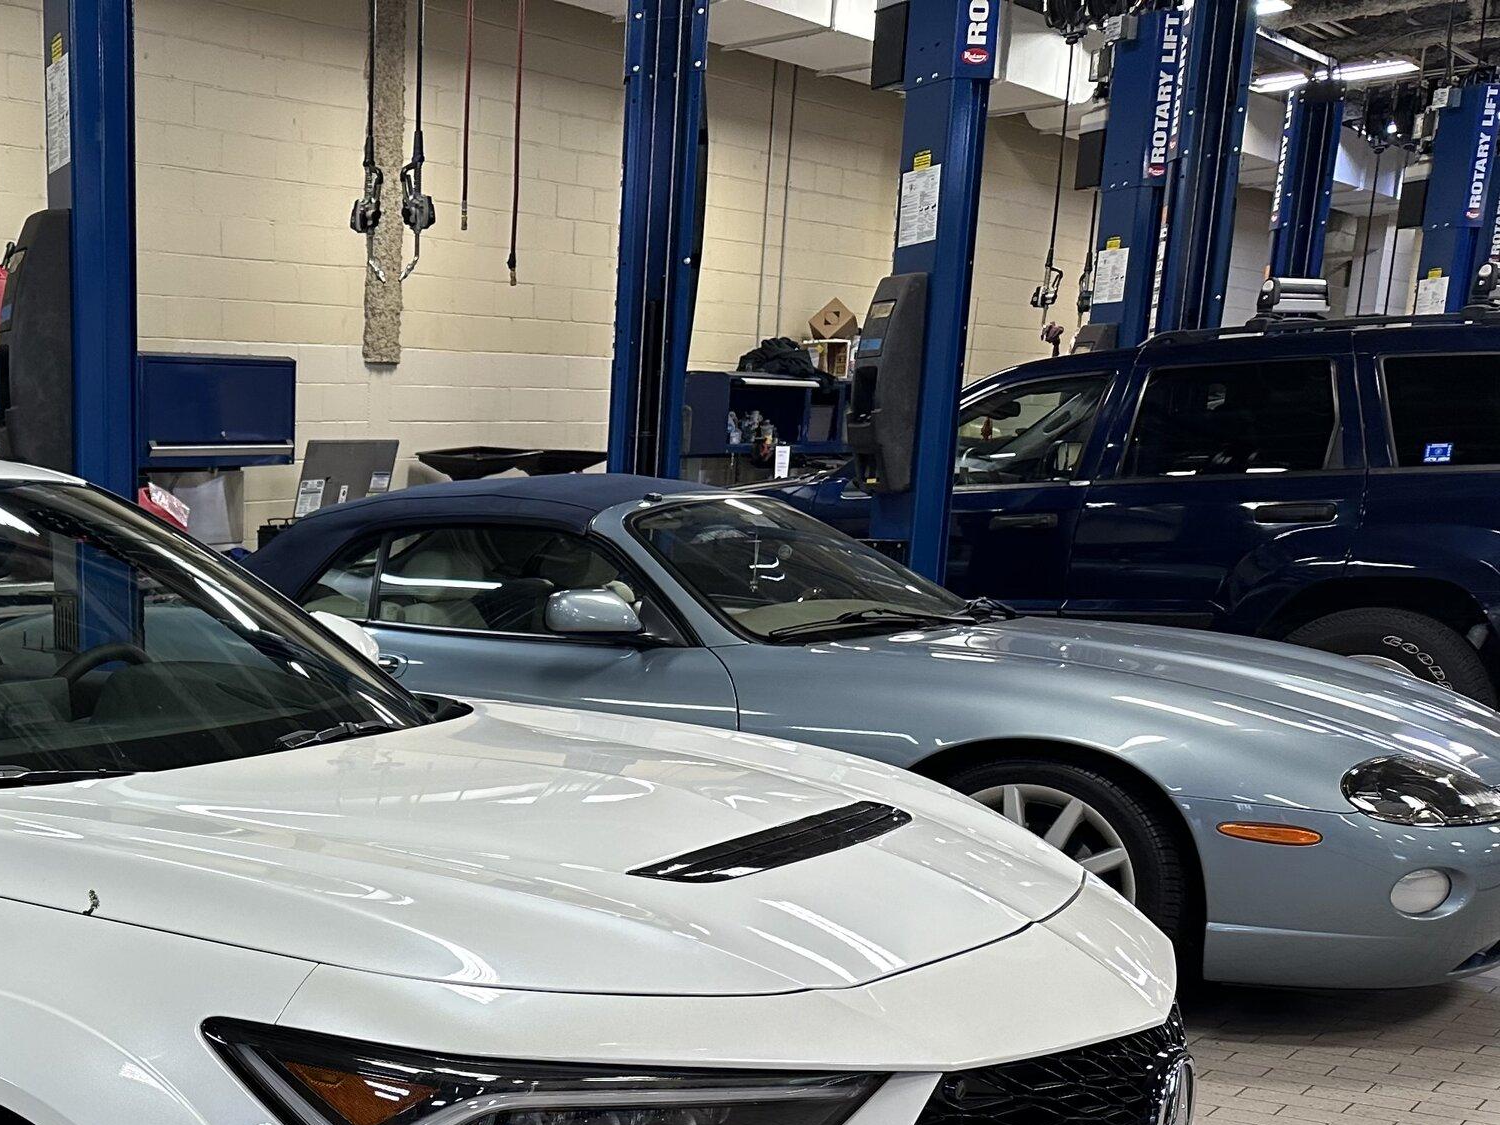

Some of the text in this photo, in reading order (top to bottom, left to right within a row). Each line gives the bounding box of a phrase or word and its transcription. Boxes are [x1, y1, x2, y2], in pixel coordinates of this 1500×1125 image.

[966, 0, 990, 44] RO
[1151, 13, 1180, 163] ROTARY LIFT
[1469, 131, 1491, 208] ROTARY
[1481, 85, 1499, 127] LIFT
